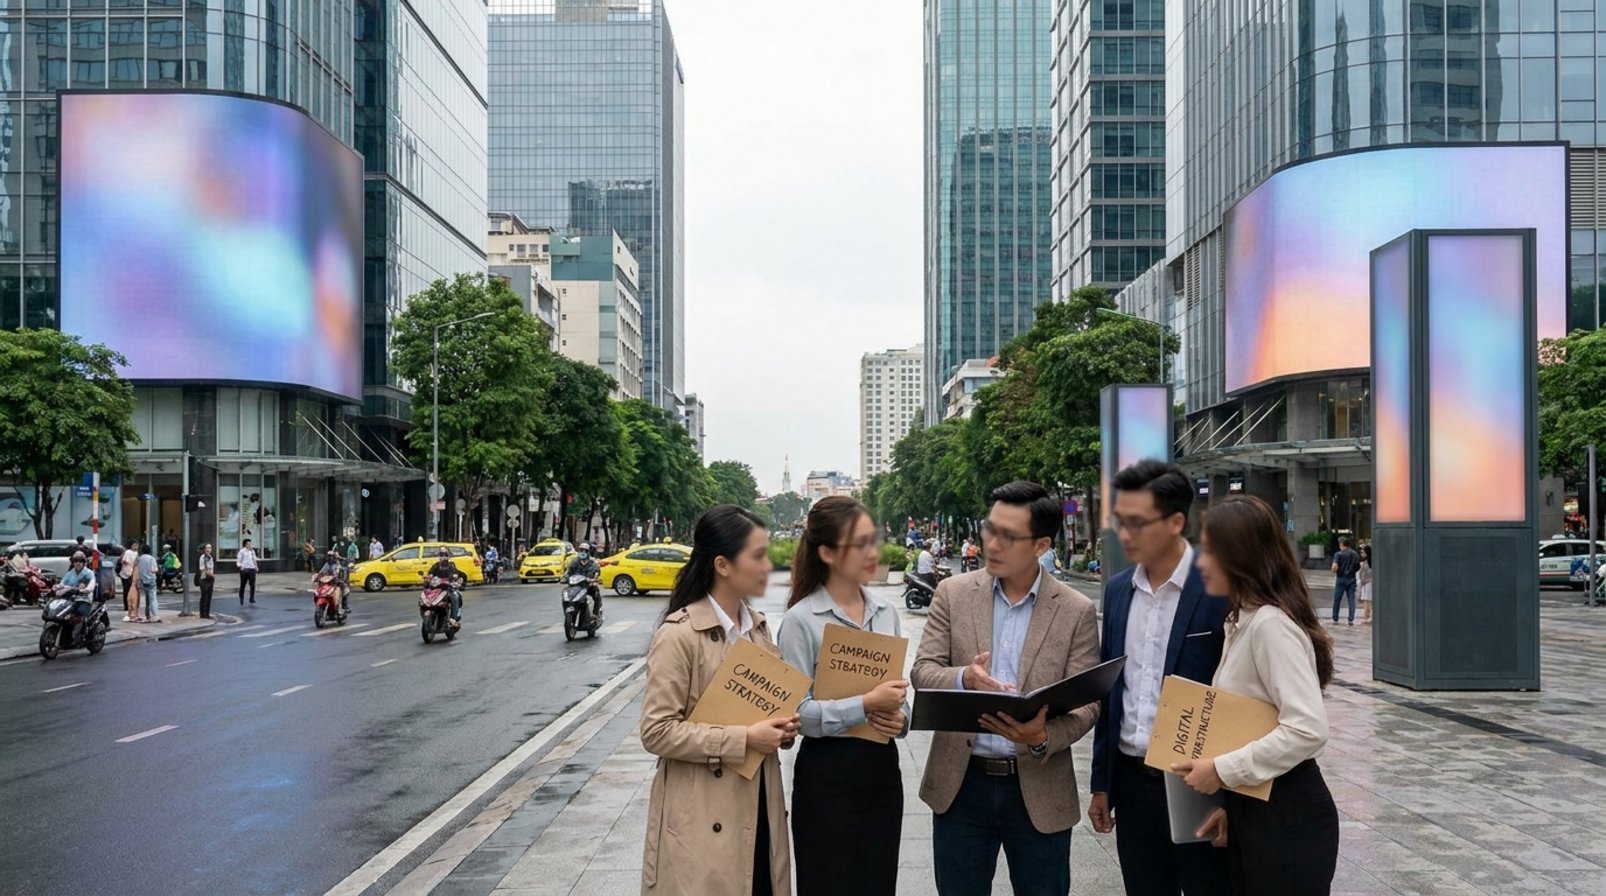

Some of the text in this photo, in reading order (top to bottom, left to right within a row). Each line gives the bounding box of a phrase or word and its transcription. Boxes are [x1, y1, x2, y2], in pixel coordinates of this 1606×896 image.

[830, 643, 891, 664] CAMPAIGN
[724, 679, 780, 717] STRATEGY
[733, 664, 792, 702] CAMPAIGN
[1173, 707, 1195, 755] DIGITAL
